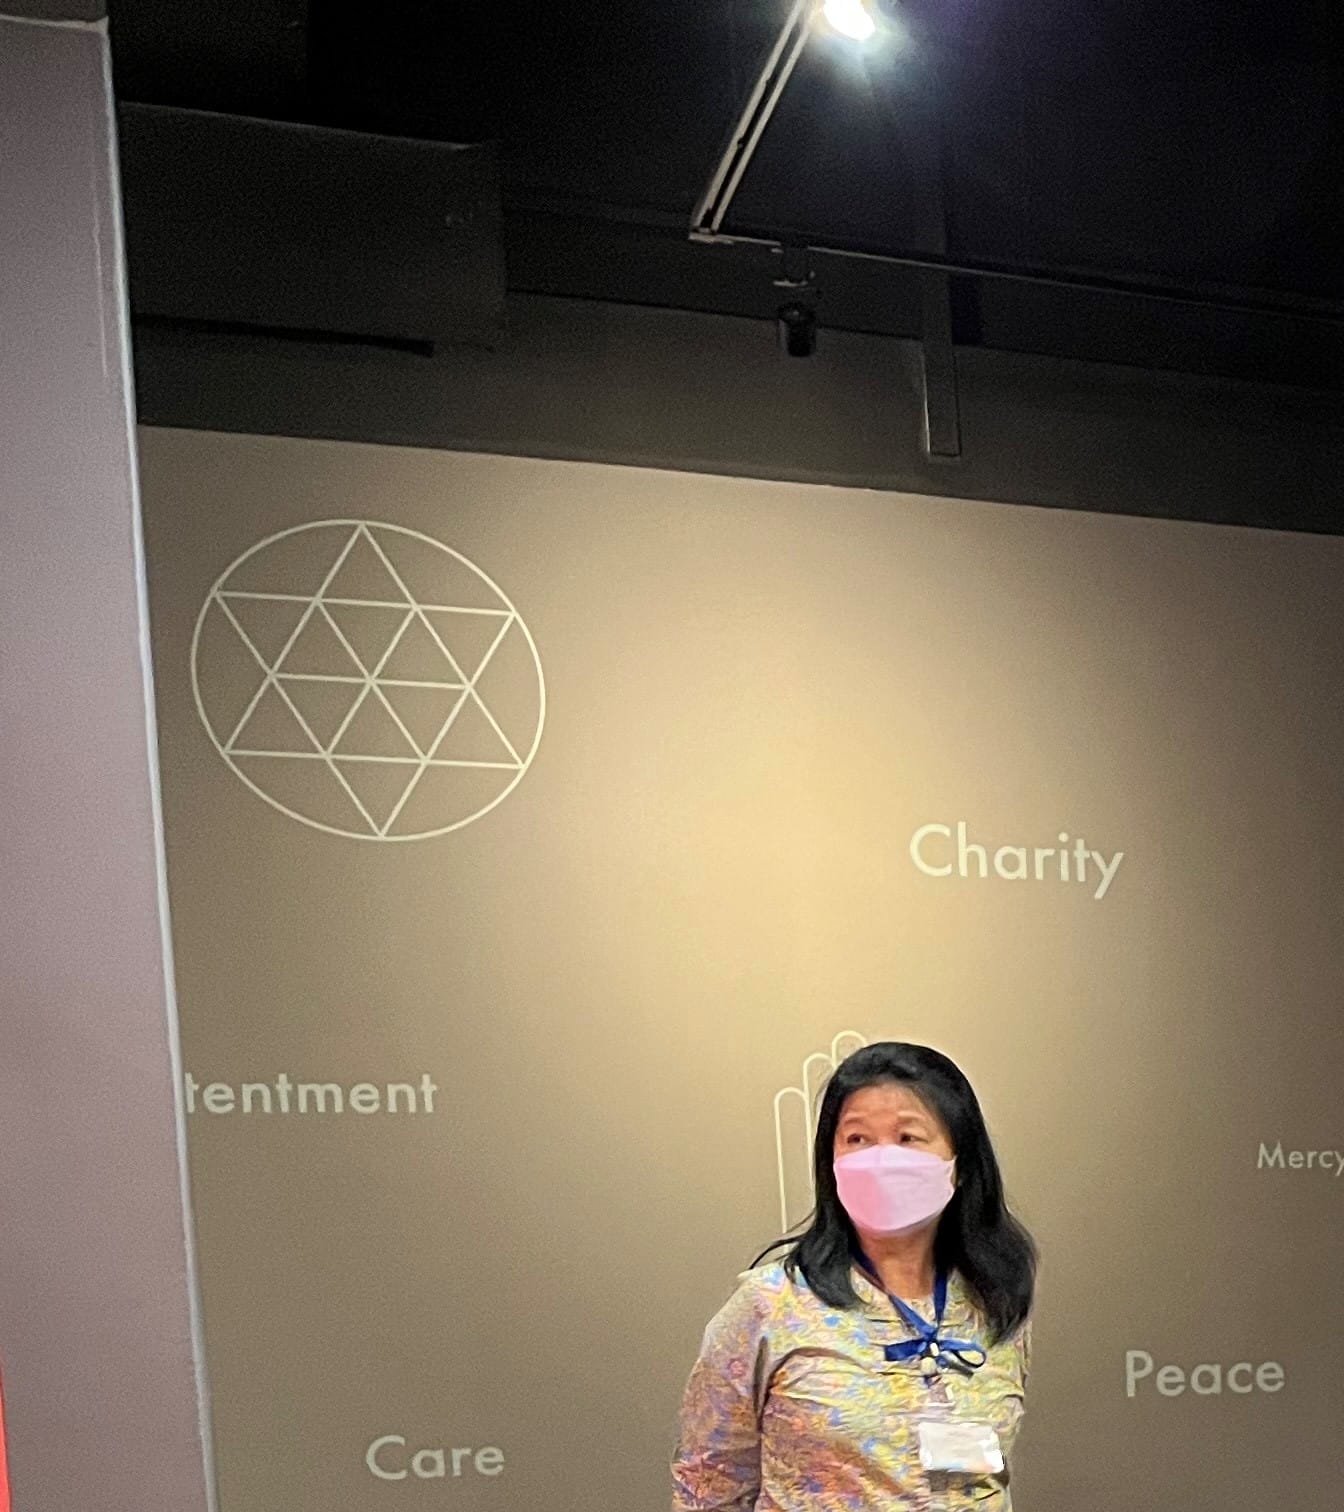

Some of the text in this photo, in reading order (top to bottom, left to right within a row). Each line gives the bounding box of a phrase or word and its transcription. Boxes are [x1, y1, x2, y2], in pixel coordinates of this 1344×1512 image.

[909, 820, 1125, 900] Charity
[1124, 1349, 1286, 1398] Peace
[365, 1434, 505, 1481] Care
